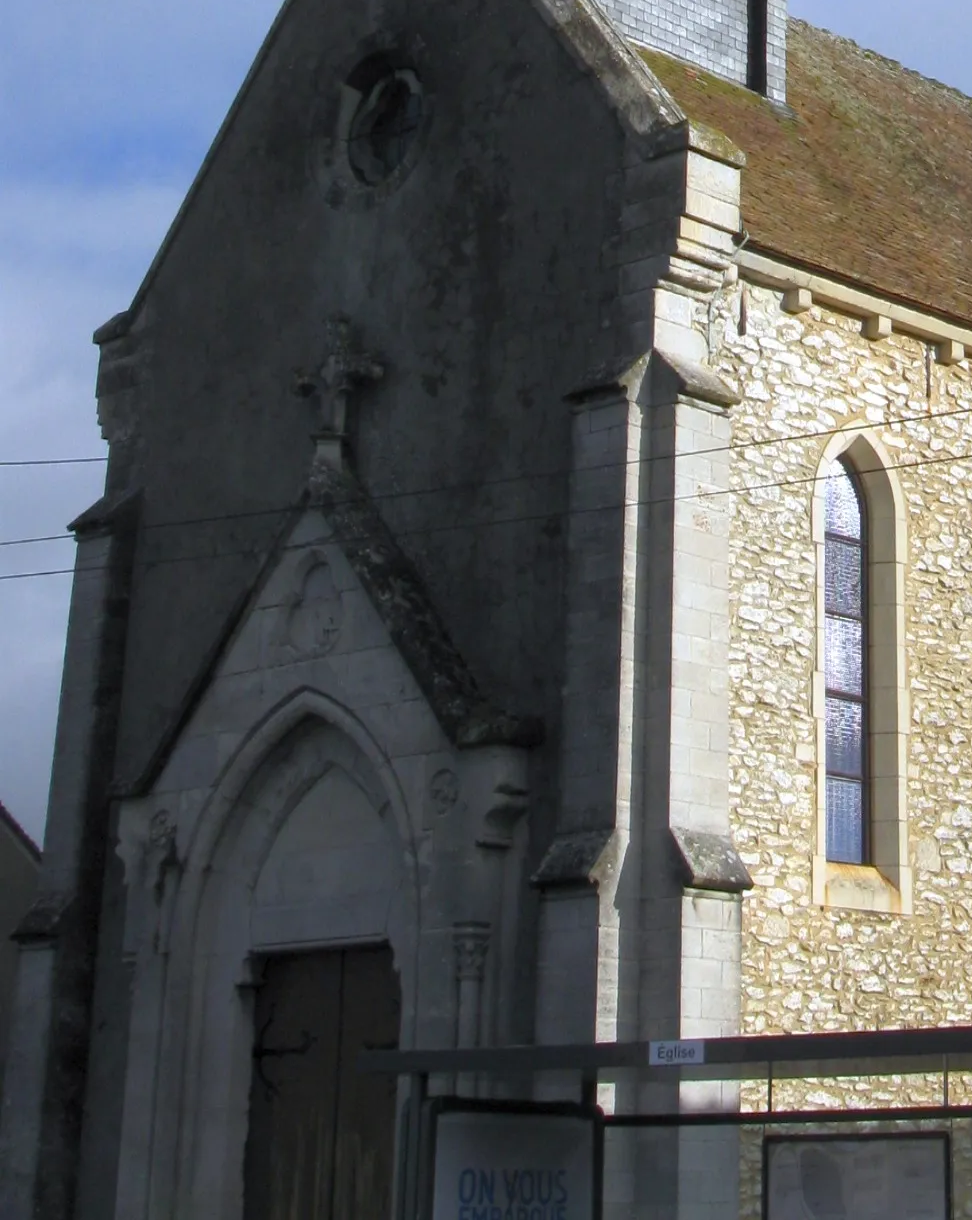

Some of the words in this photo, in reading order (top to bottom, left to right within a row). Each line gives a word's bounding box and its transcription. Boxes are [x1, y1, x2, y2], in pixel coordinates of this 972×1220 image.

[657, 1043, 695, 1062] Église
[458, 1168, 495, 1205] ON
[503, 1168, 568, 1205] VOUS
